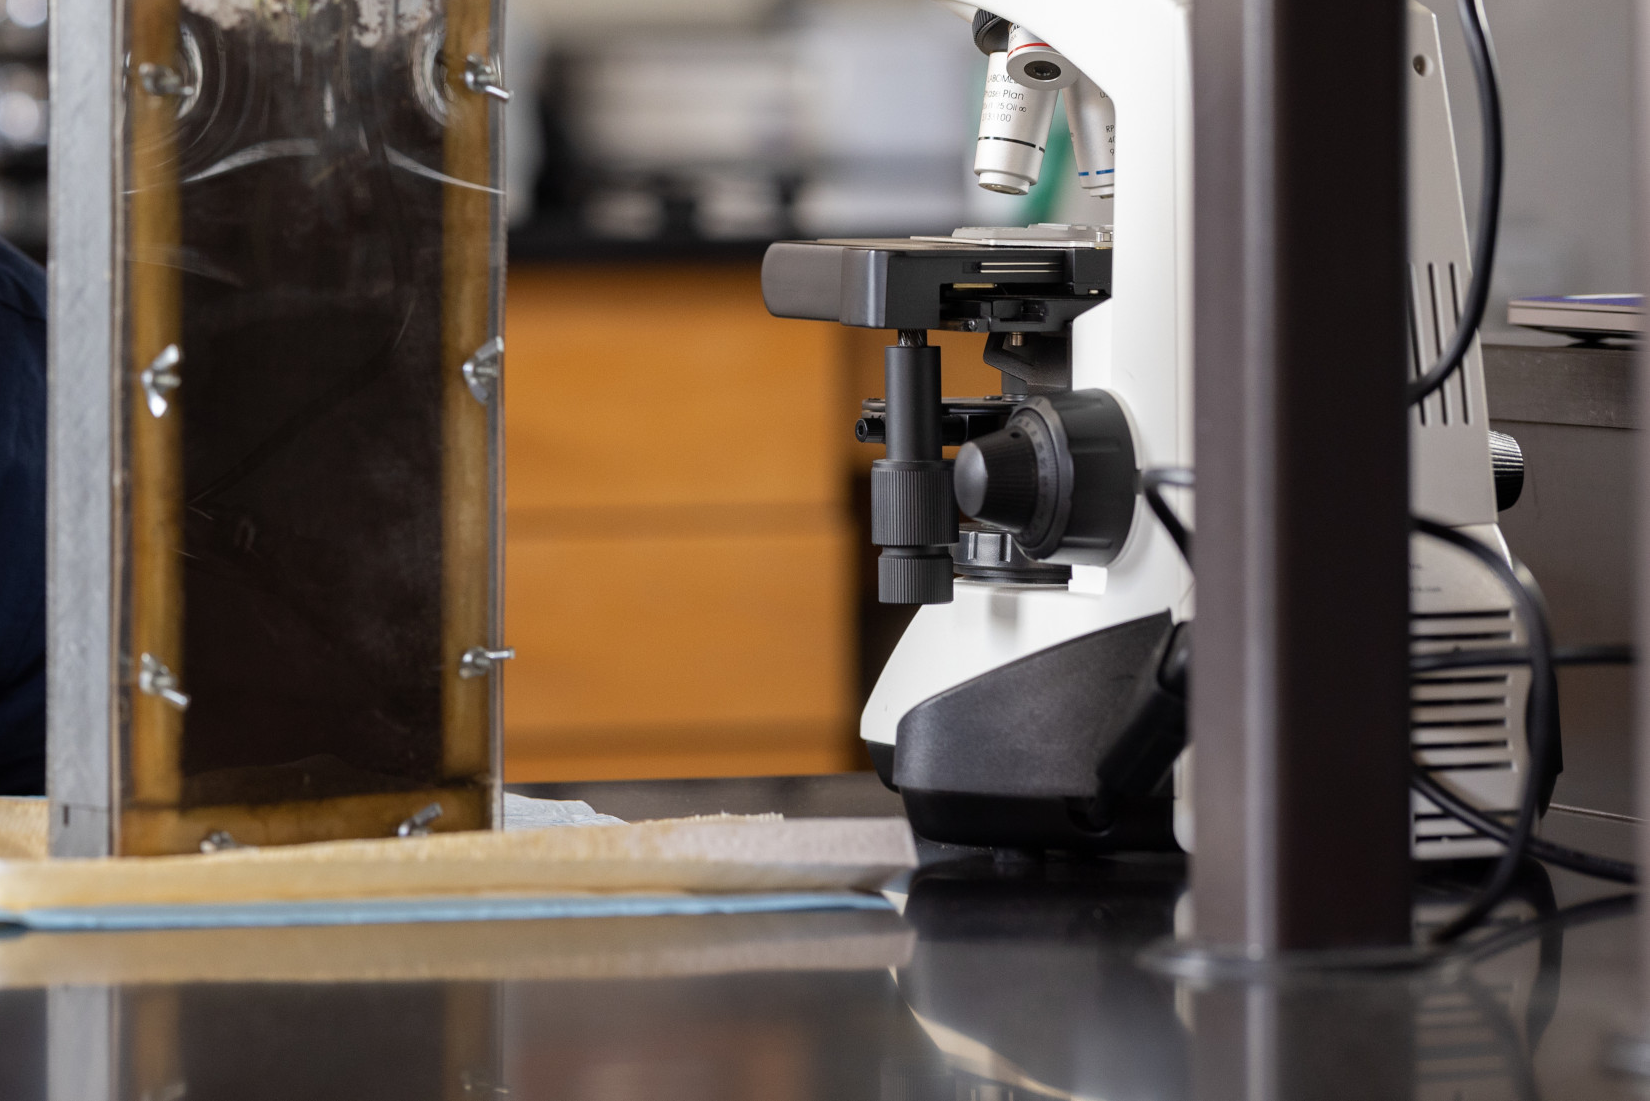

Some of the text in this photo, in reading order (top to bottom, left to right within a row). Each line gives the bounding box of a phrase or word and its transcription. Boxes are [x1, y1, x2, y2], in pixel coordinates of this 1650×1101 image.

[987, 74, 1019, 84] LABOME
[1002, 89, 1024, 100] Plan
[1005, 103, 1018, 111] Oil
